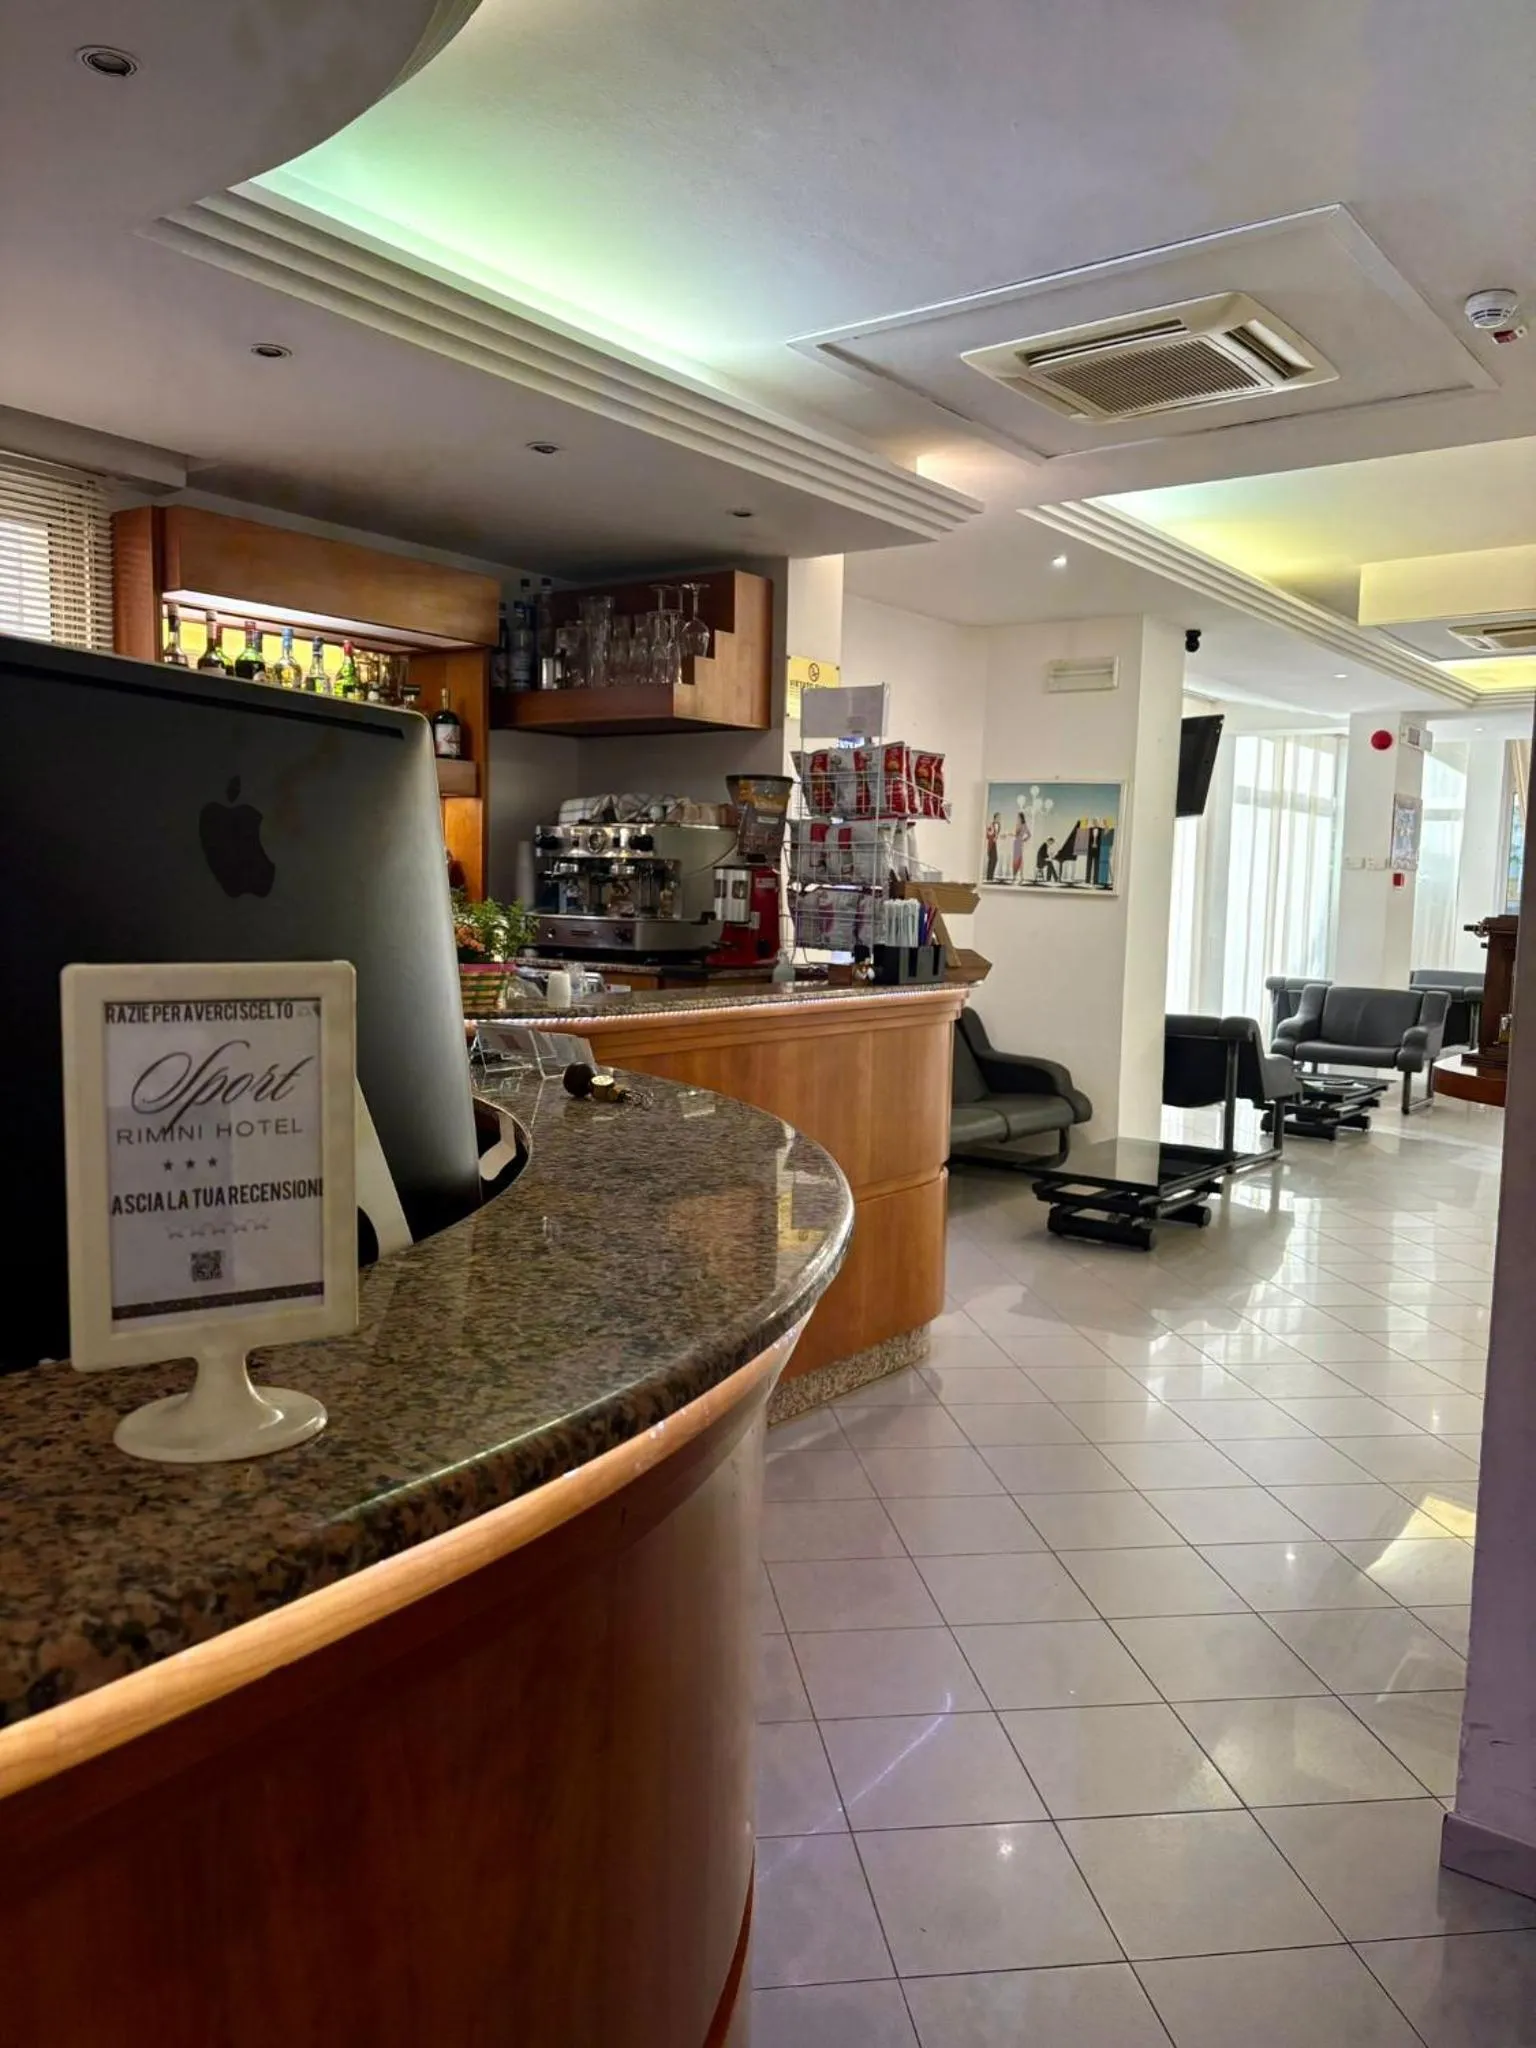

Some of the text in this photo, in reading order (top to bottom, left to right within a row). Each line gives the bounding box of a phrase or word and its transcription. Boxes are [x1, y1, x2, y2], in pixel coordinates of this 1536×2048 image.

[152, 1003, 180, 1023] PER
[184, 1002, 237, 1022] AVERCI
[239, 1002, 293, 1020] SCELTO
[131, 1040, 315, 1136] Sport
[117, 1117, 303, 1146] RIMINI HOTEL
[168, 1189, 189, 1211] LA
[192, 1186, 228, 1209] TUA
